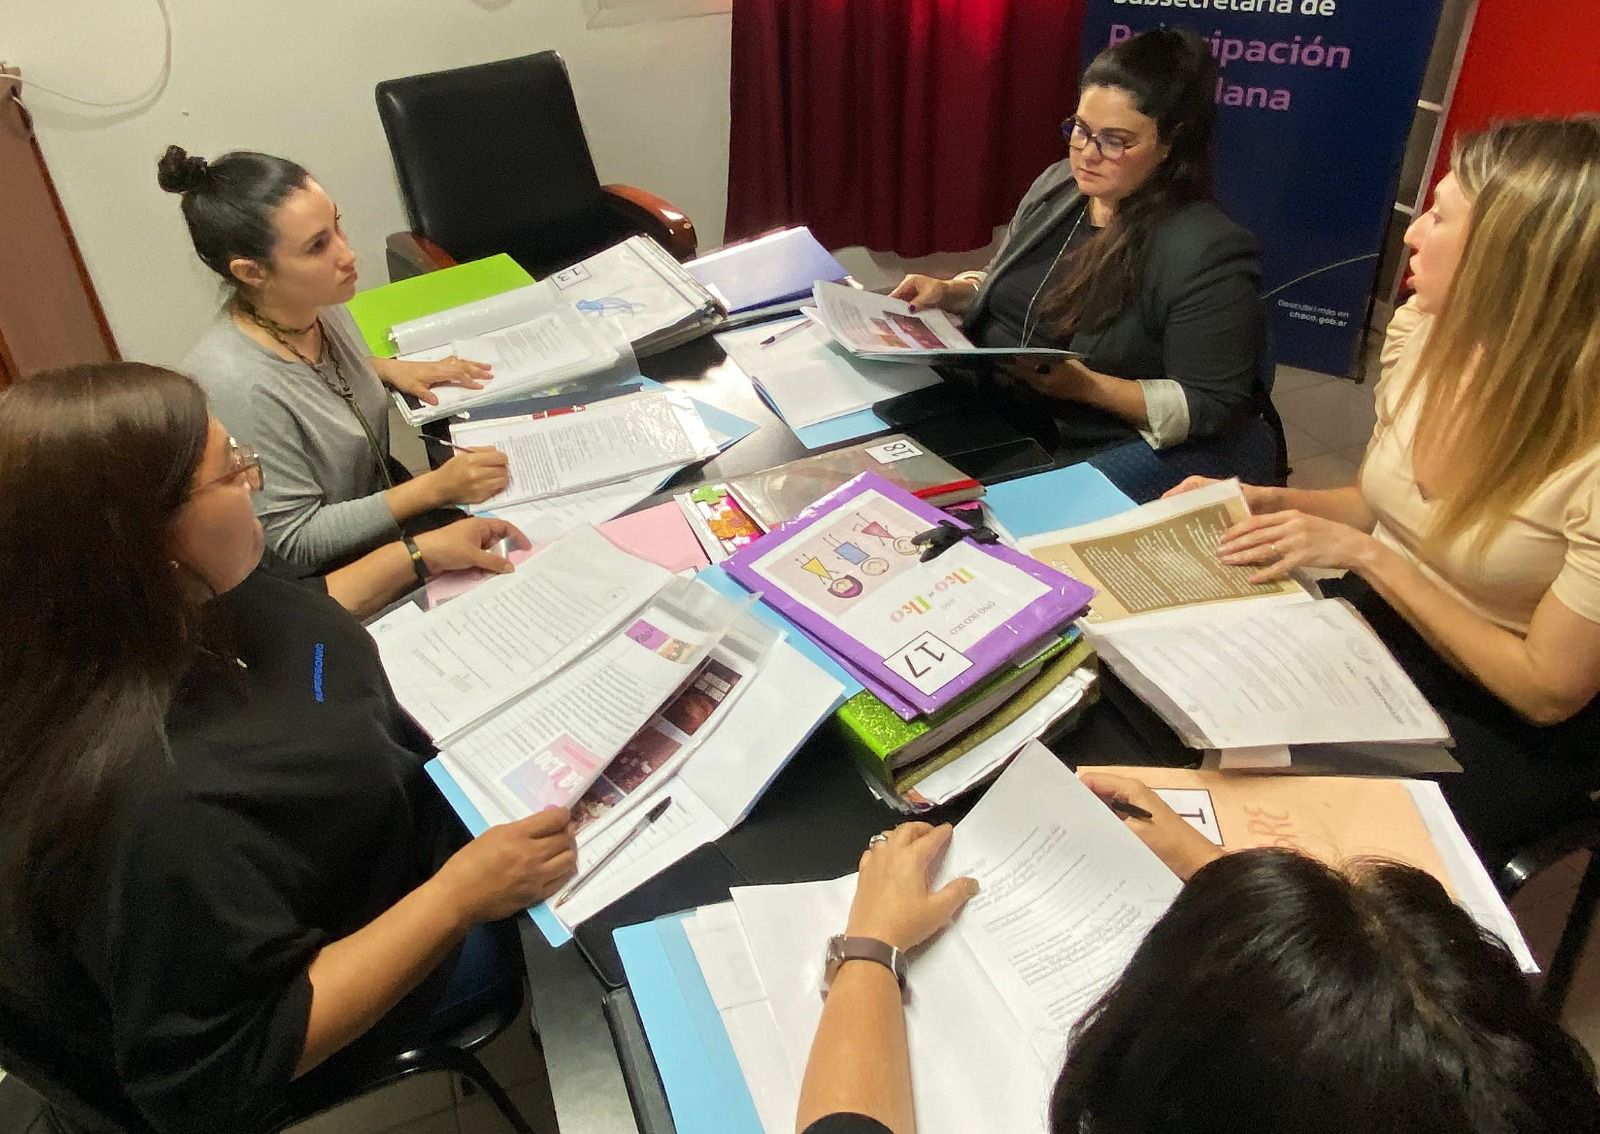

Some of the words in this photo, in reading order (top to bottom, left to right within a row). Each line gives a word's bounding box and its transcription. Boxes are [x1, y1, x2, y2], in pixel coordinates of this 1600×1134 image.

[1300, 0, 1336, 16] de
[557, 267, 581, 282] 13
[883, 443, 915, 457] 18
[903, 641, 946, 679] 17
